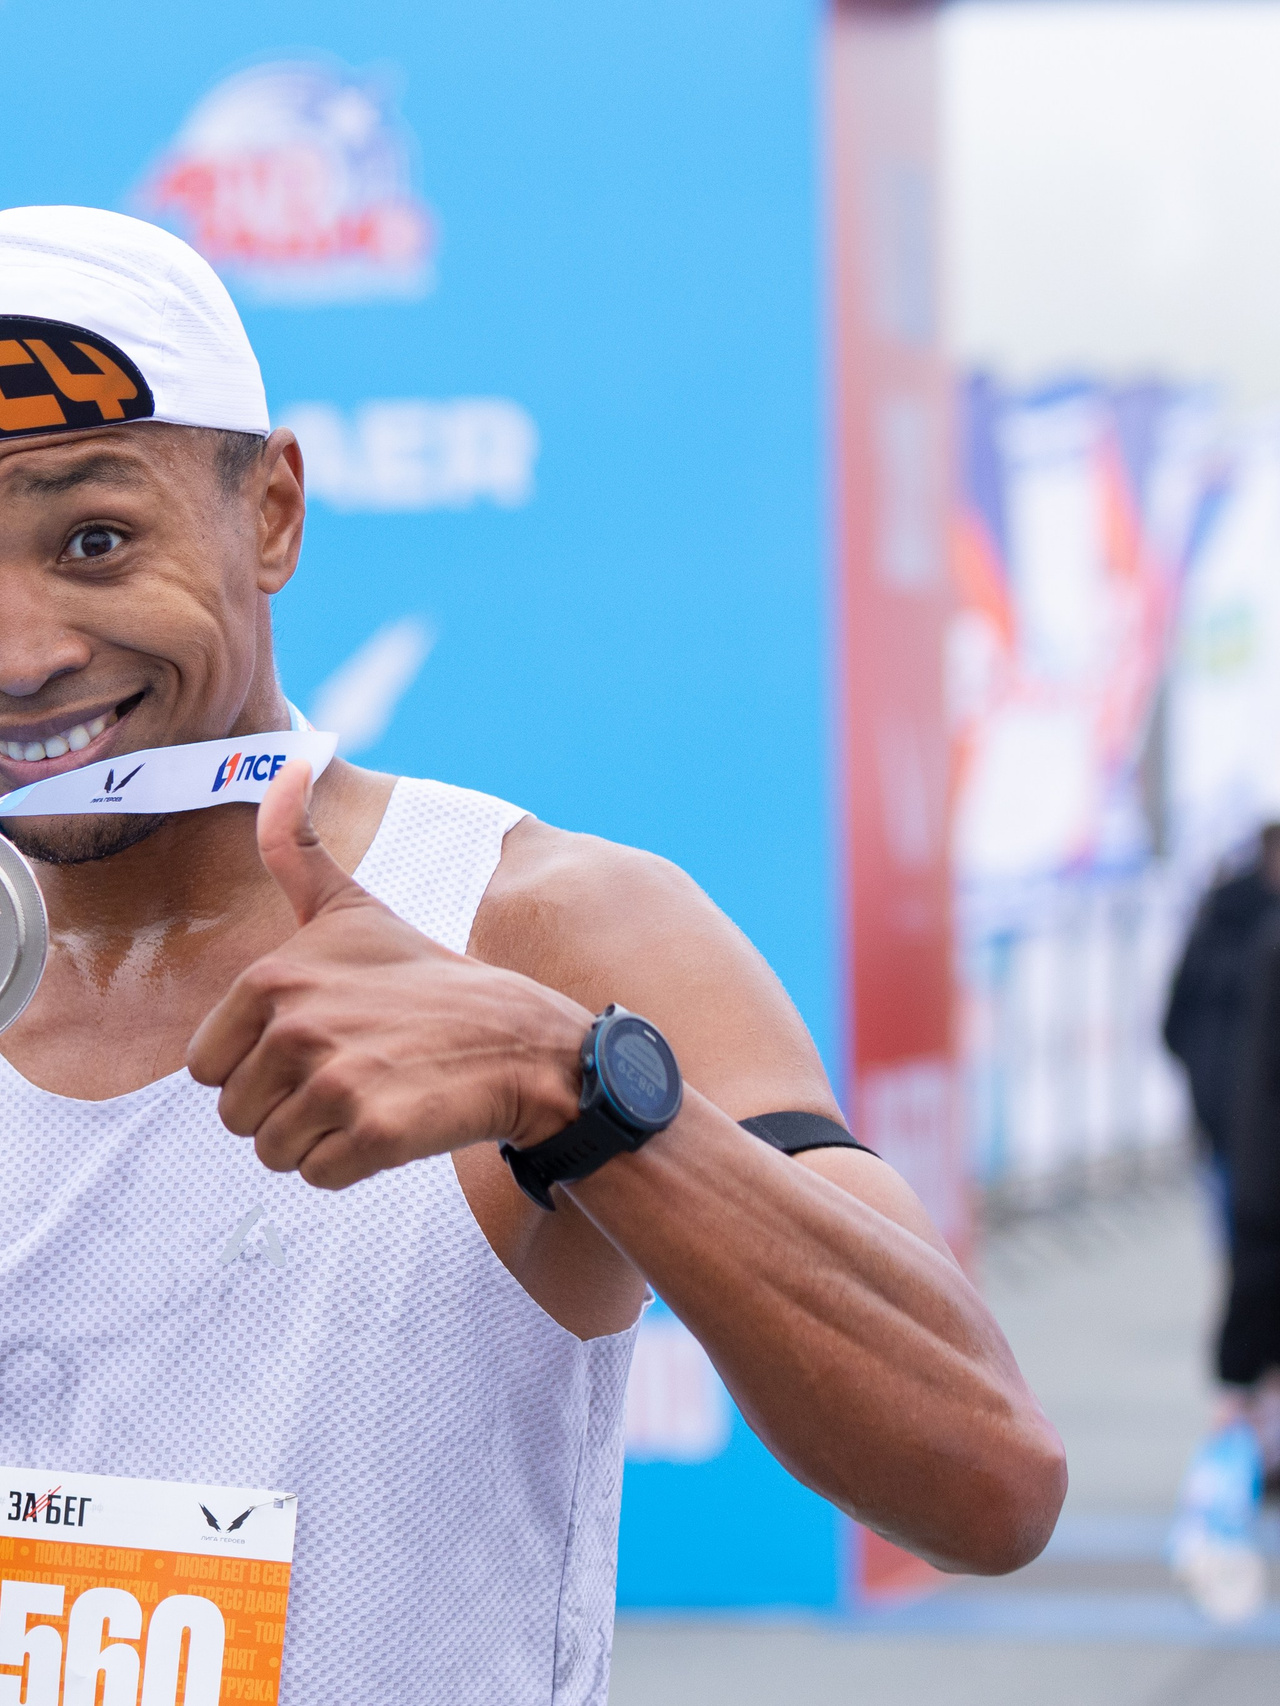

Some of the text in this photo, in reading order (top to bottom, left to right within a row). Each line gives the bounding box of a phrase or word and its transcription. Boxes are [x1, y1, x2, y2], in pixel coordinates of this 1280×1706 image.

[34, 1542, 144, 1572] ПОКА ВСЕ СПЯТ
[174, 1555, 220, 1580] ЛЮБИ
[221, 1560, 249, 1583] БЕГ
[249, 1562, 260, 1584] В
